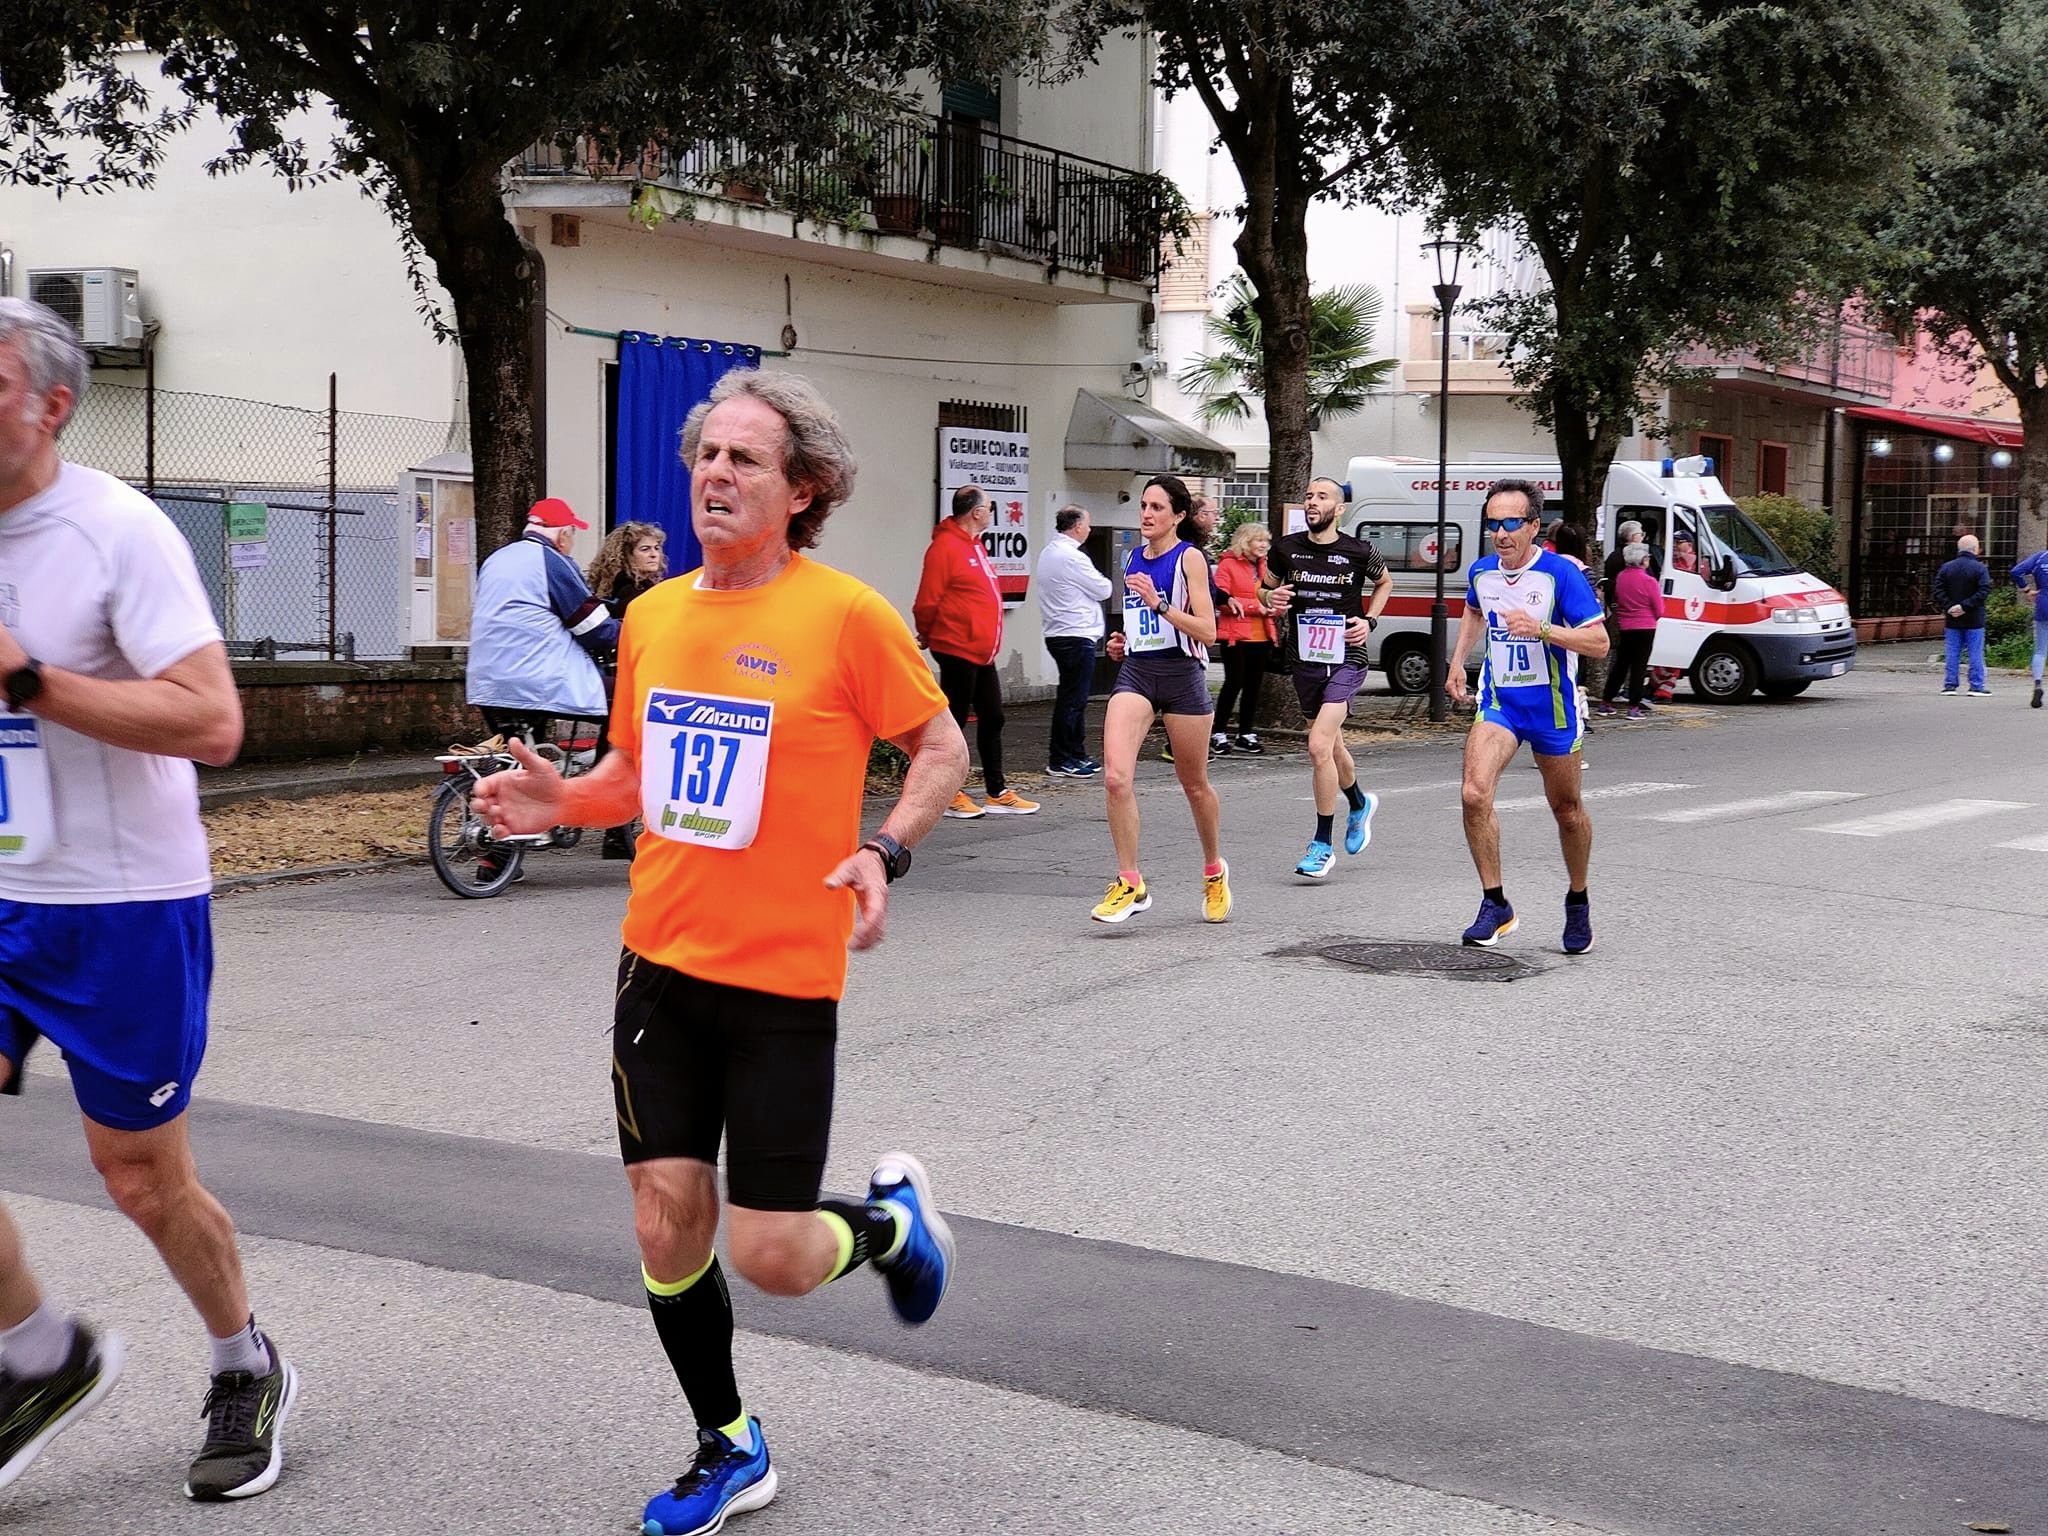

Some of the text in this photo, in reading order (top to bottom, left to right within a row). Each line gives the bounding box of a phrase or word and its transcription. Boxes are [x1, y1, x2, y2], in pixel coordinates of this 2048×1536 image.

[1411, 481, 1496, 491] CROCE ROS
[981, 532, 1028, 558] arco
[1308, 626, 1337, 651] 227
[736, 654, 777, 676] AVIS
[1506, 644, 1530, 672] 79
[687, 705, 766, 731] MIZUNO
[670, 731, 741, 808] 137
[694, 831, 722, 840] SPORT
